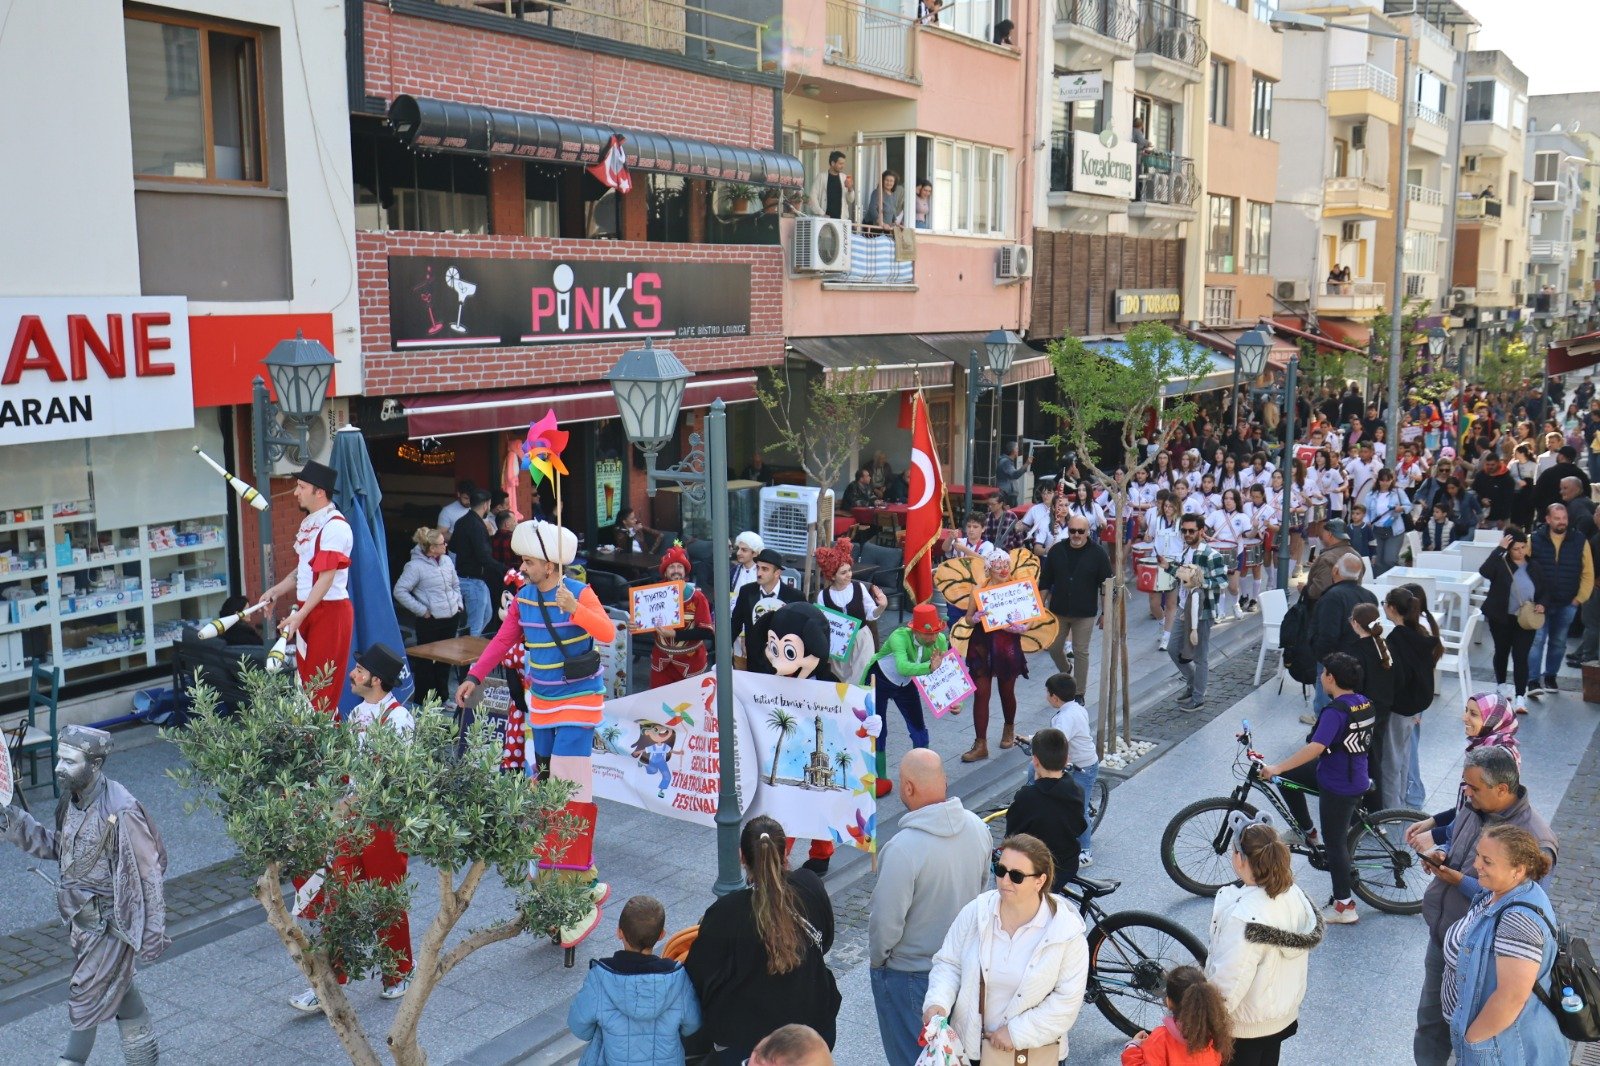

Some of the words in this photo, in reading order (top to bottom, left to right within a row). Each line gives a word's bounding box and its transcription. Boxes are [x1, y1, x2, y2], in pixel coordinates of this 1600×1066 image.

[678, 326, 696, 336] CAFE
[1, 312, 175, 385] ANE
[0, 395, 93, 428] ARAN
